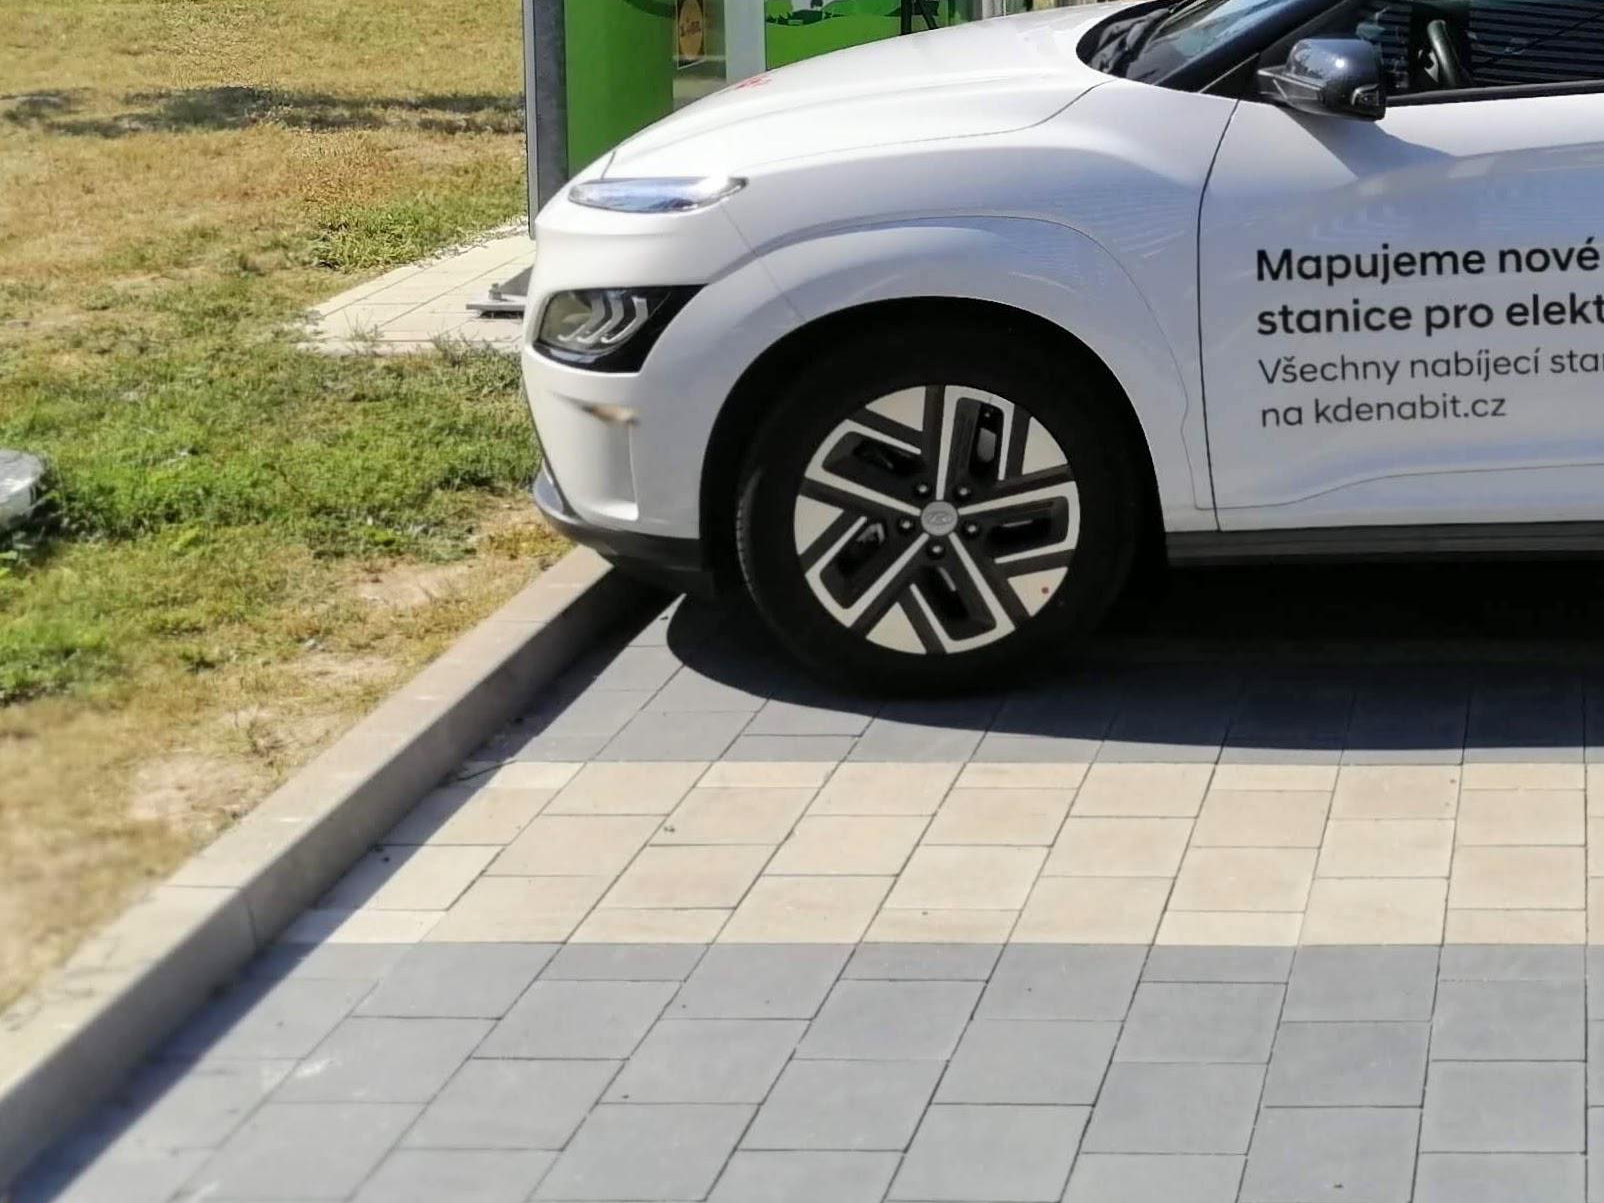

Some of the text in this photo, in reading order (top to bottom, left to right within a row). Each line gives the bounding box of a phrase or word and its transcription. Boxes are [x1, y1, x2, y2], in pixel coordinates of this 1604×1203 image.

[1256, 243, 1486, 287] Mapujeme
[1498, 237, 1601, 274] nové
[1257, 298, 1412, 336] stanice
[1425, 302, 1494, 337] pro
[1259, 353, 1400, 386] Všechny
[1410, 348, 1541, 383] nabíjecí
[1261, 392, 1507, 428] na kdenabit.cz
